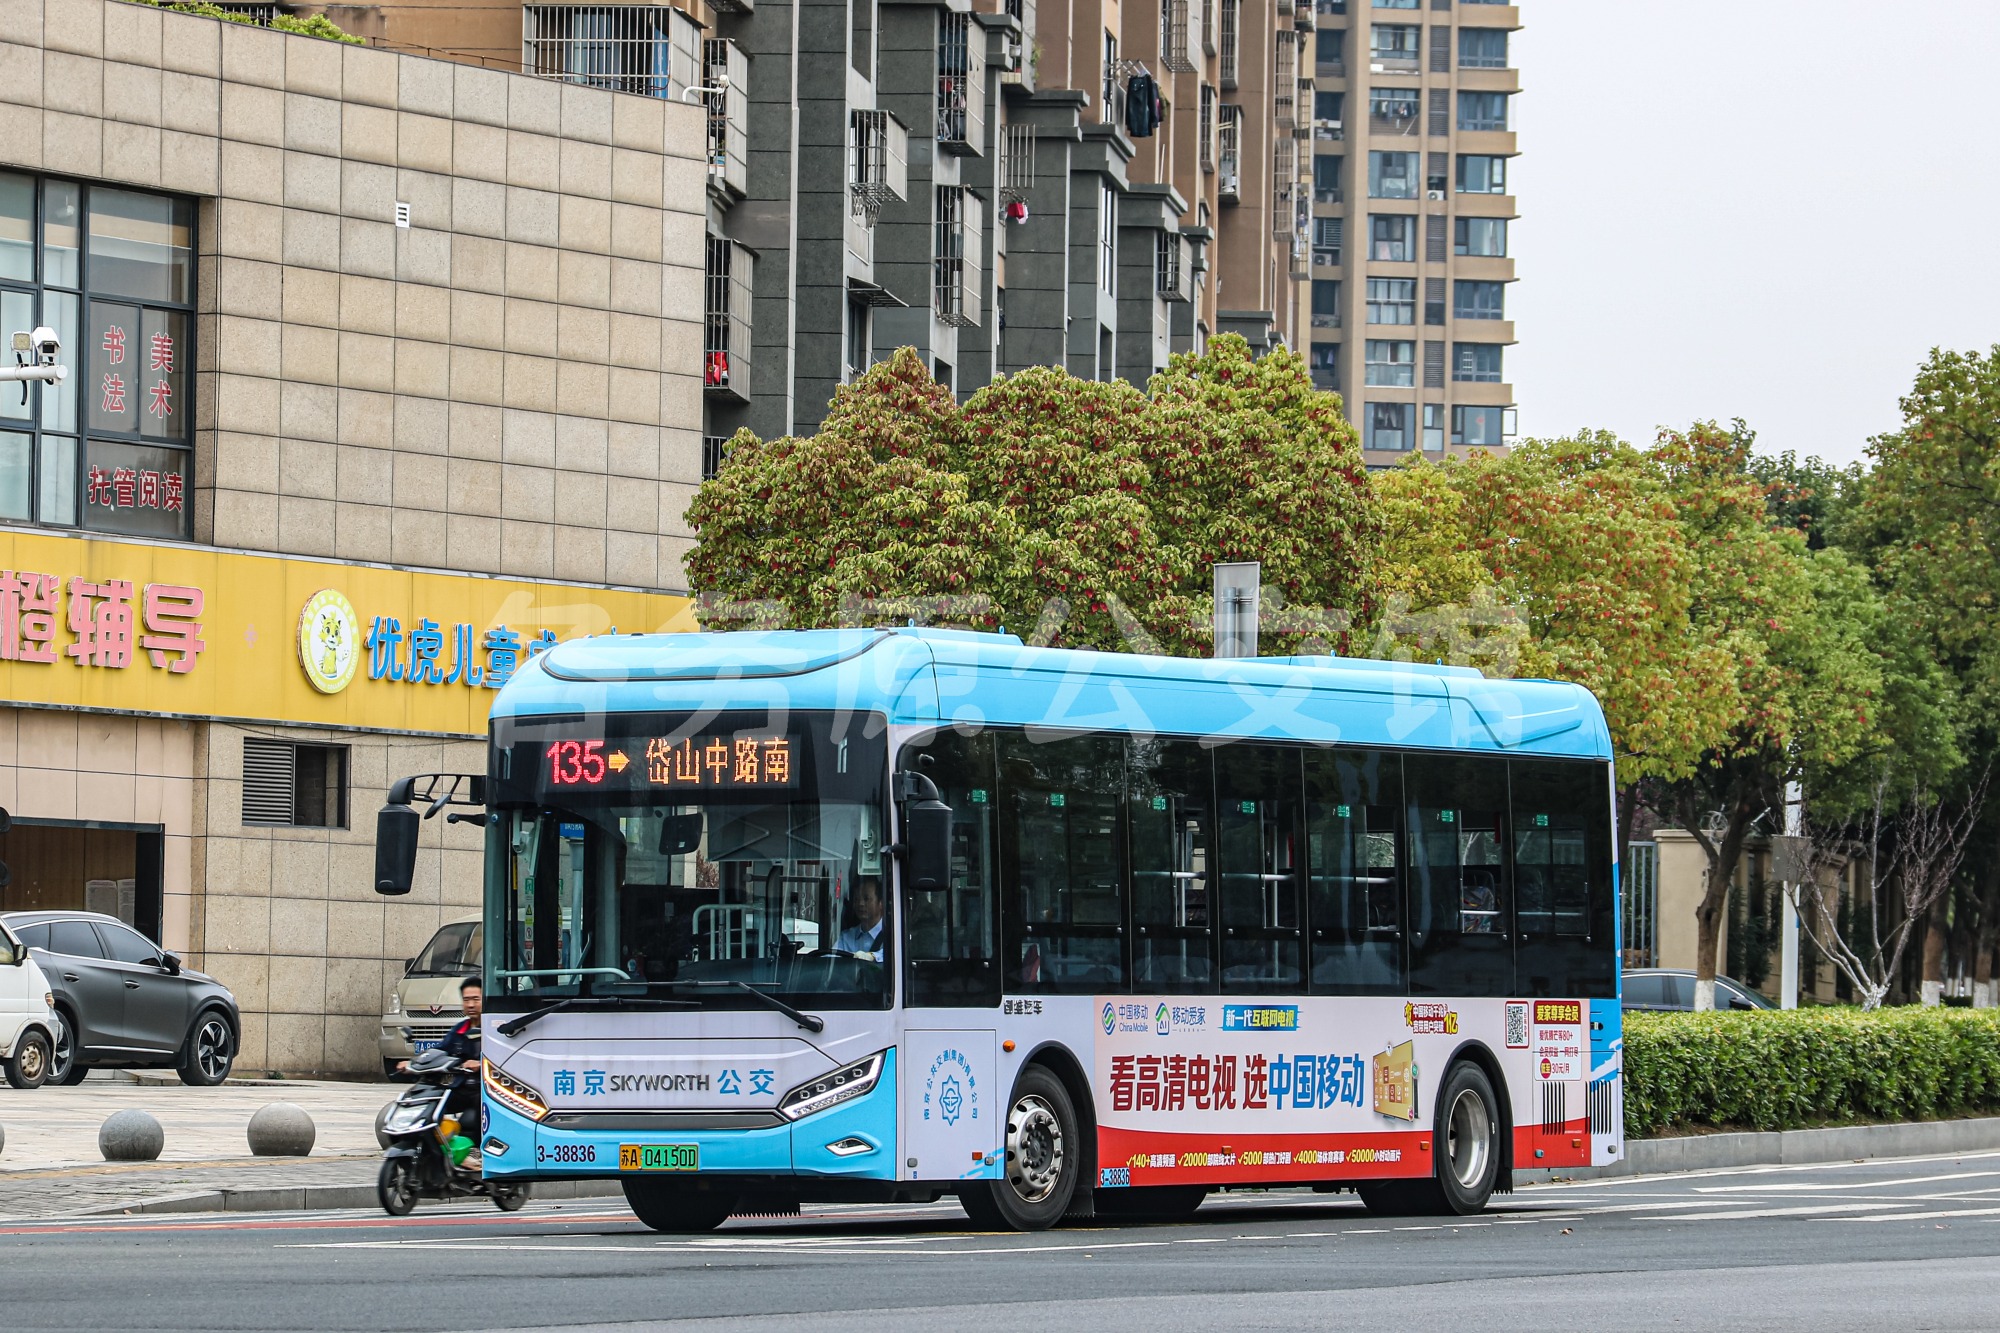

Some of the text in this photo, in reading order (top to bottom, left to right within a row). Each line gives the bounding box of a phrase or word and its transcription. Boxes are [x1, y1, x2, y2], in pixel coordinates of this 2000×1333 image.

[102, 324, 126, 413] 书法
[149, 332, 174, 418] 美术
[88, 465, 184, 512] 托管阅读
[363, 615, 560, 688] 优虎儿童
[546, 736, 790, 785] 135 岱山中路南
[1118, 1004, 1149, 1020] 中国移动
[1172, 1006, 1206, 1026] 移动爱家
[1225, 1009, 1295, 1027] 新一代互联网电视
[1536, 1005, 1579, 1021] 爱家尊享会员
[1119, 1022, 1149, 1032] China Mobile
[553, 1069, 775, 1096] 南京 SKYWORTH 公交
[1110, 1053, 1236, 1112] 看高清电视
[1242, 1053, 1365, 1110] 选中国移动
[537, 1144, 596, 1163] 3-38836
[1100, 1168, 1130, 1186] 3-38836
